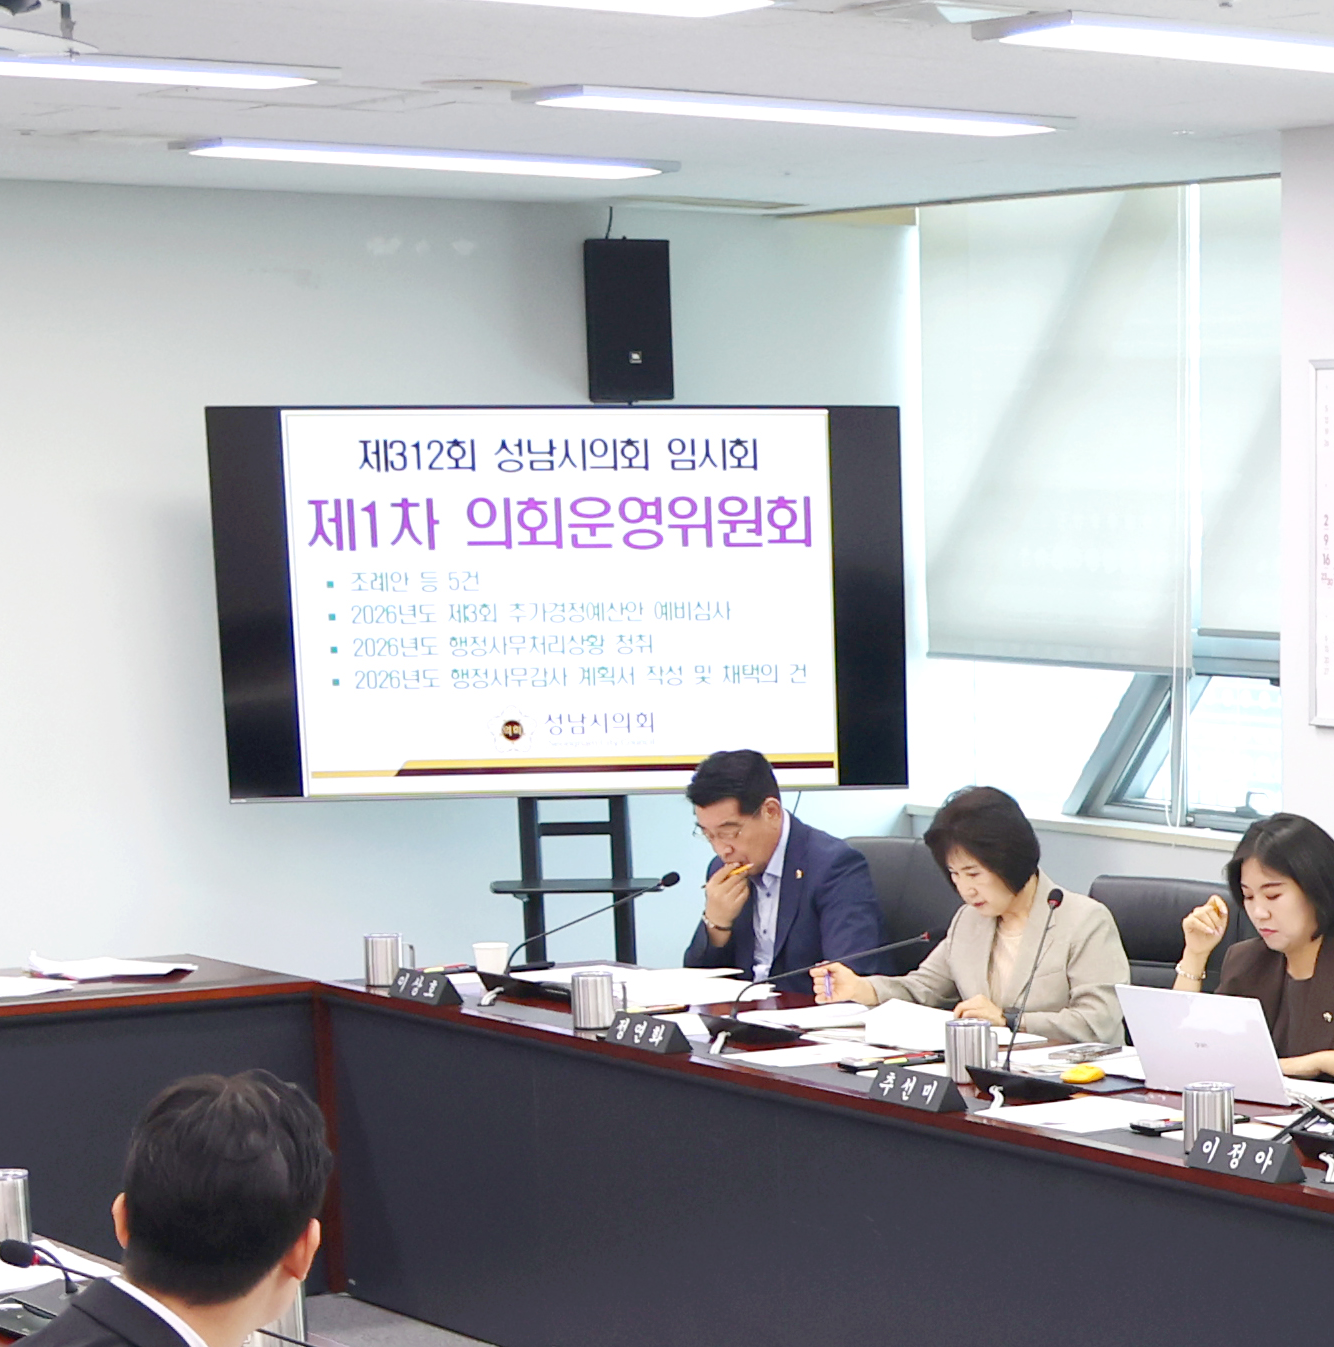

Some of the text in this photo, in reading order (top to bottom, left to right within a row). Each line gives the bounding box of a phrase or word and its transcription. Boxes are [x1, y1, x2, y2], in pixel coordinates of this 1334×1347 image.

[357, 437, 759, 474] 제312회 성남시의회 임시회
[306, 495, 813, 552] 제1차 의회운영위원회
[1323, 513, 1329, 527] 2
[1323, 533, 1329, 546] 9
[1322, 553, 1331, 566] 16
[351, 570, 479, 593] 조례안 등 5건
[350, 600, 731, 625] 2026년도 제3회 추가경정예산안 예비심사
[352, 633, 653, 658] 2026년도 행정사무처리상황 청취
[354, 663, 807, 690] 2026년도 행정사무감사 계획서 작성 및 채택의 건
[544, 711, 654, 736] 성남시의회
[879, 1072, 938, 1105] 추선미
[1202, 1136, 1274, 1175] 이정아
